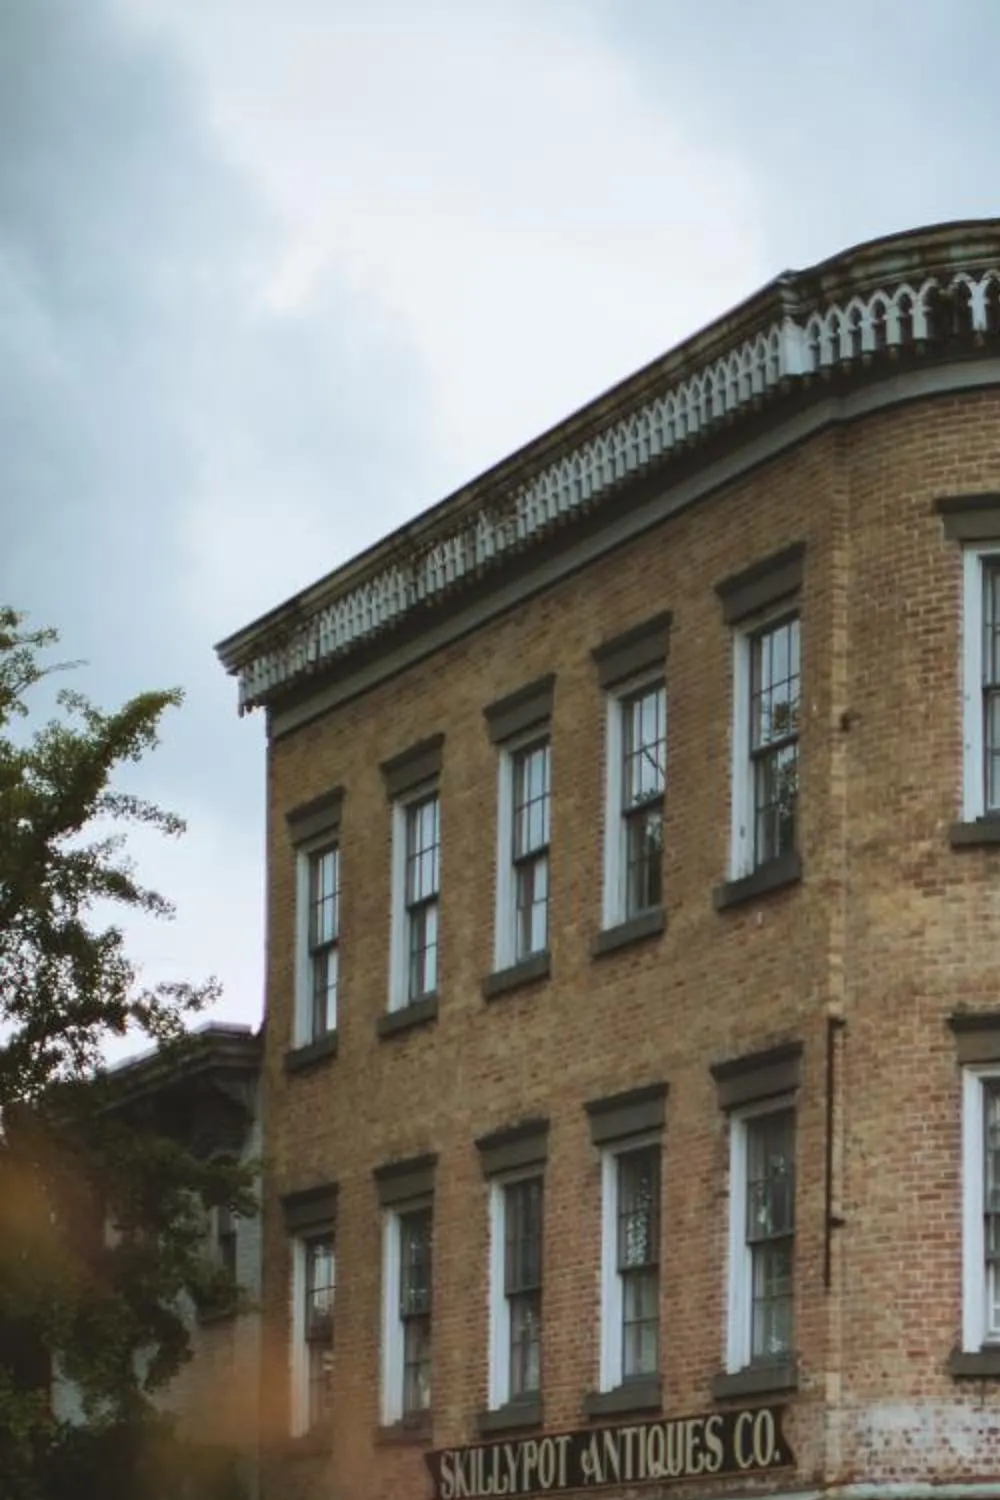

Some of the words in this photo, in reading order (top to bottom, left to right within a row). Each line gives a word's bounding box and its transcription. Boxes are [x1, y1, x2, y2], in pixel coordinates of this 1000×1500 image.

[440, 1435, 572, 1500] SKILLYPOT
[581, 1415, 724, 1484] ANTIQUES
[734, 1408, 781, 1469] CO.
